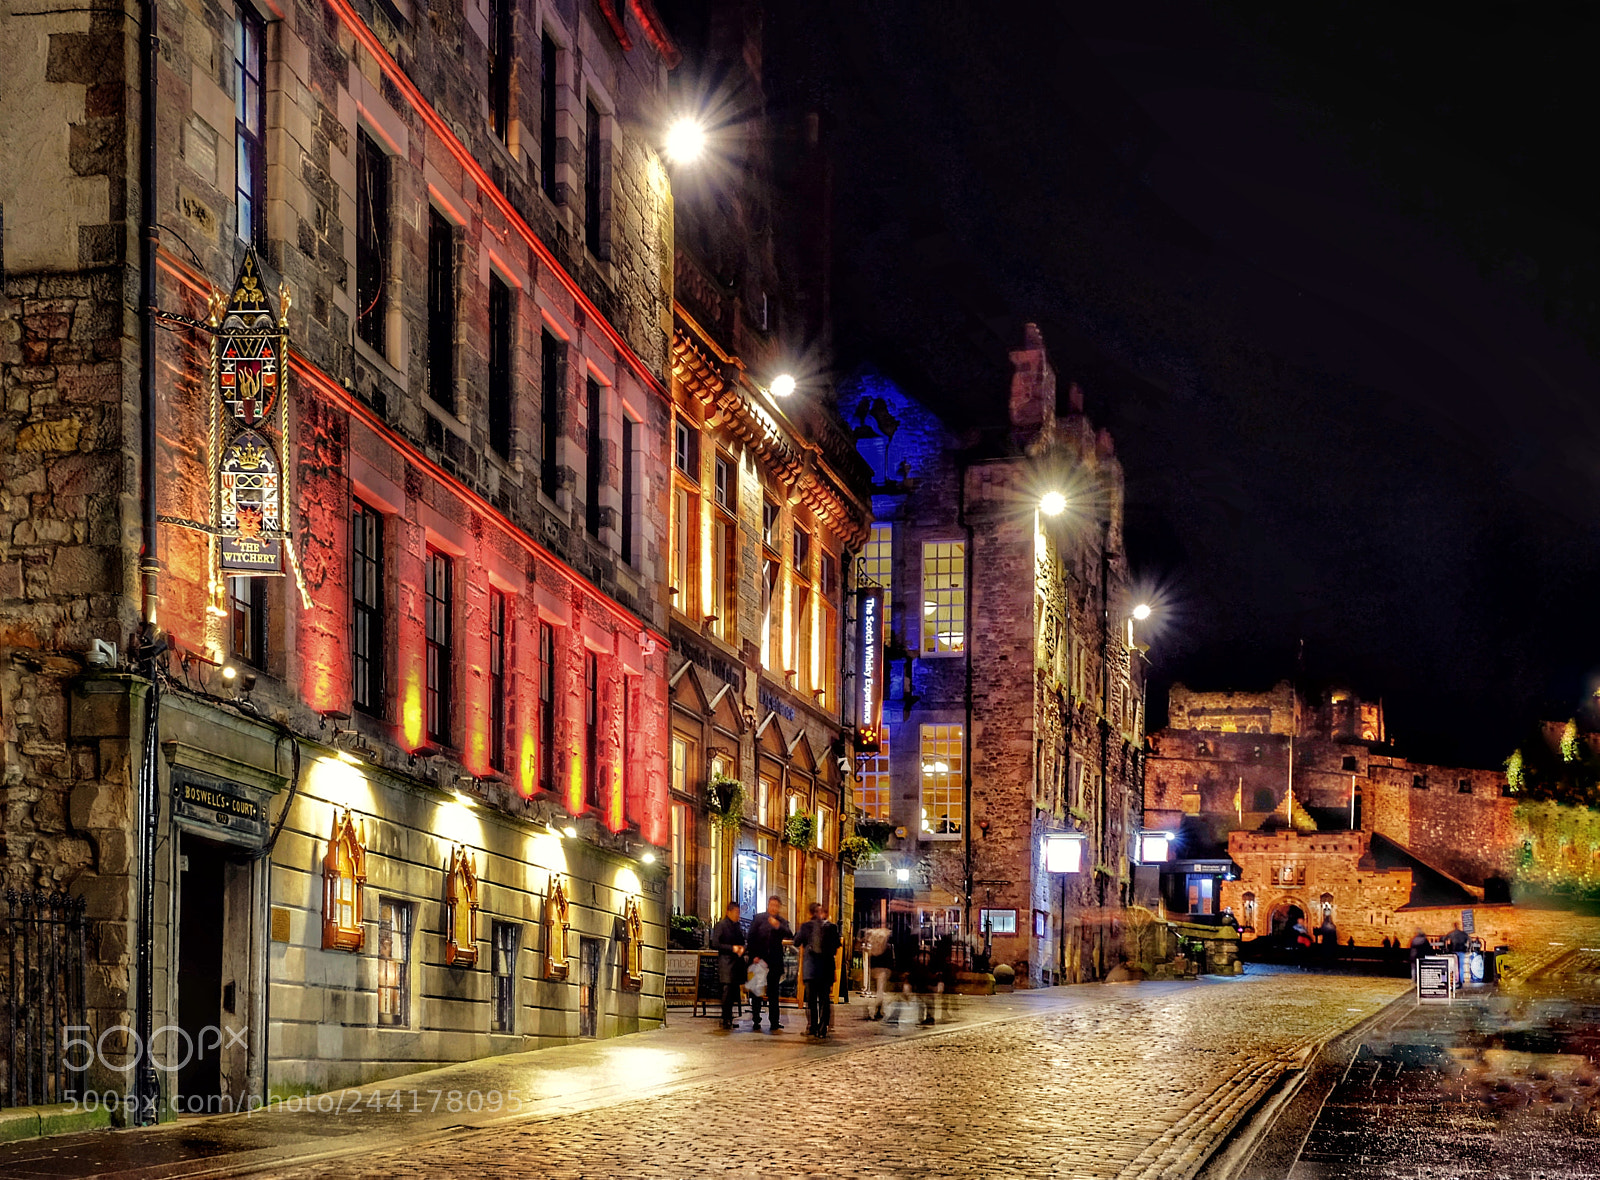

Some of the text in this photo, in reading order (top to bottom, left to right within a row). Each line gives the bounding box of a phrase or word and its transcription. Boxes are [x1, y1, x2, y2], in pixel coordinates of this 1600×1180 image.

[223, 552, 277, 564] WITCHERY
[240, 542, 260, 552] THE
[863, 598, 875, 725] The Scotch Whisky Experience
[185, 785, 254, 817] BOSWELL'S COURT
